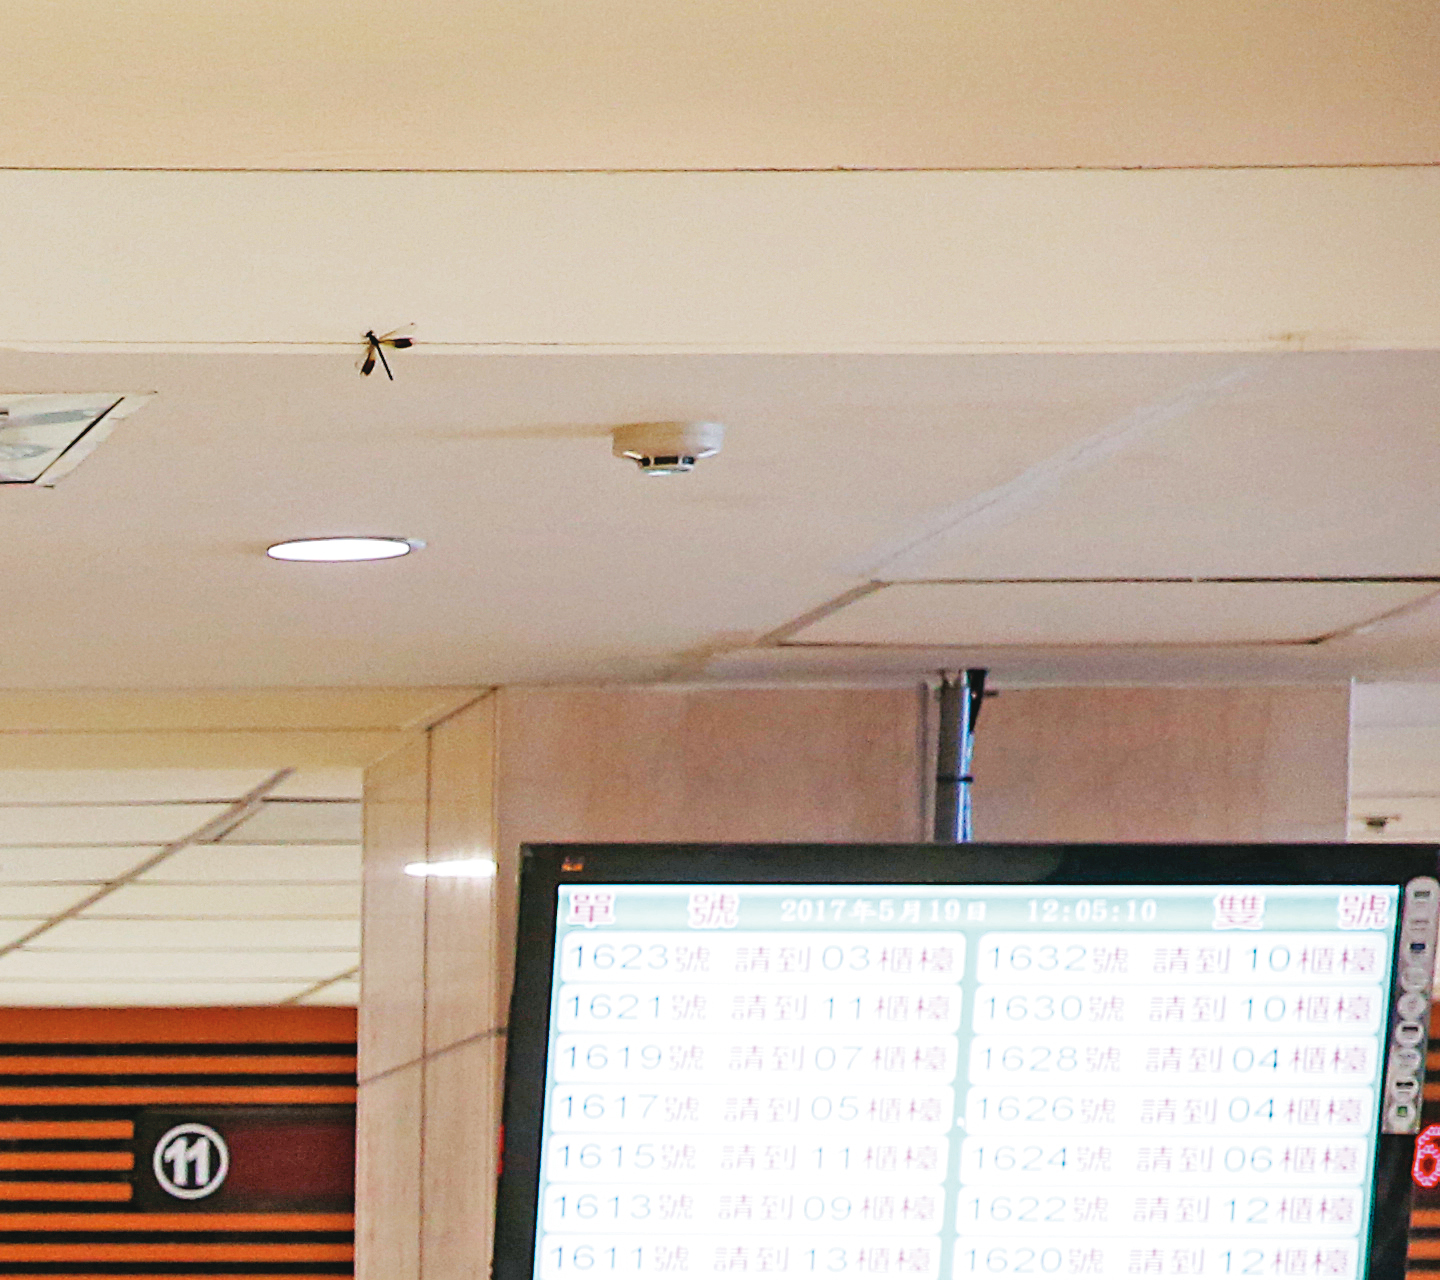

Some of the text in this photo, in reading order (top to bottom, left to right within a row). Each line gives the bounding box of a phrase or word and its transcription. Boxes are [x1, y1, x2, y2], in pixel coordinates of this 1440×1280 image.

[781, 899, 987, 924] 2017年5月19日
[1027, 899, 1156, 922] 12:05:10
[165, 1136, 213, 1184] 11
